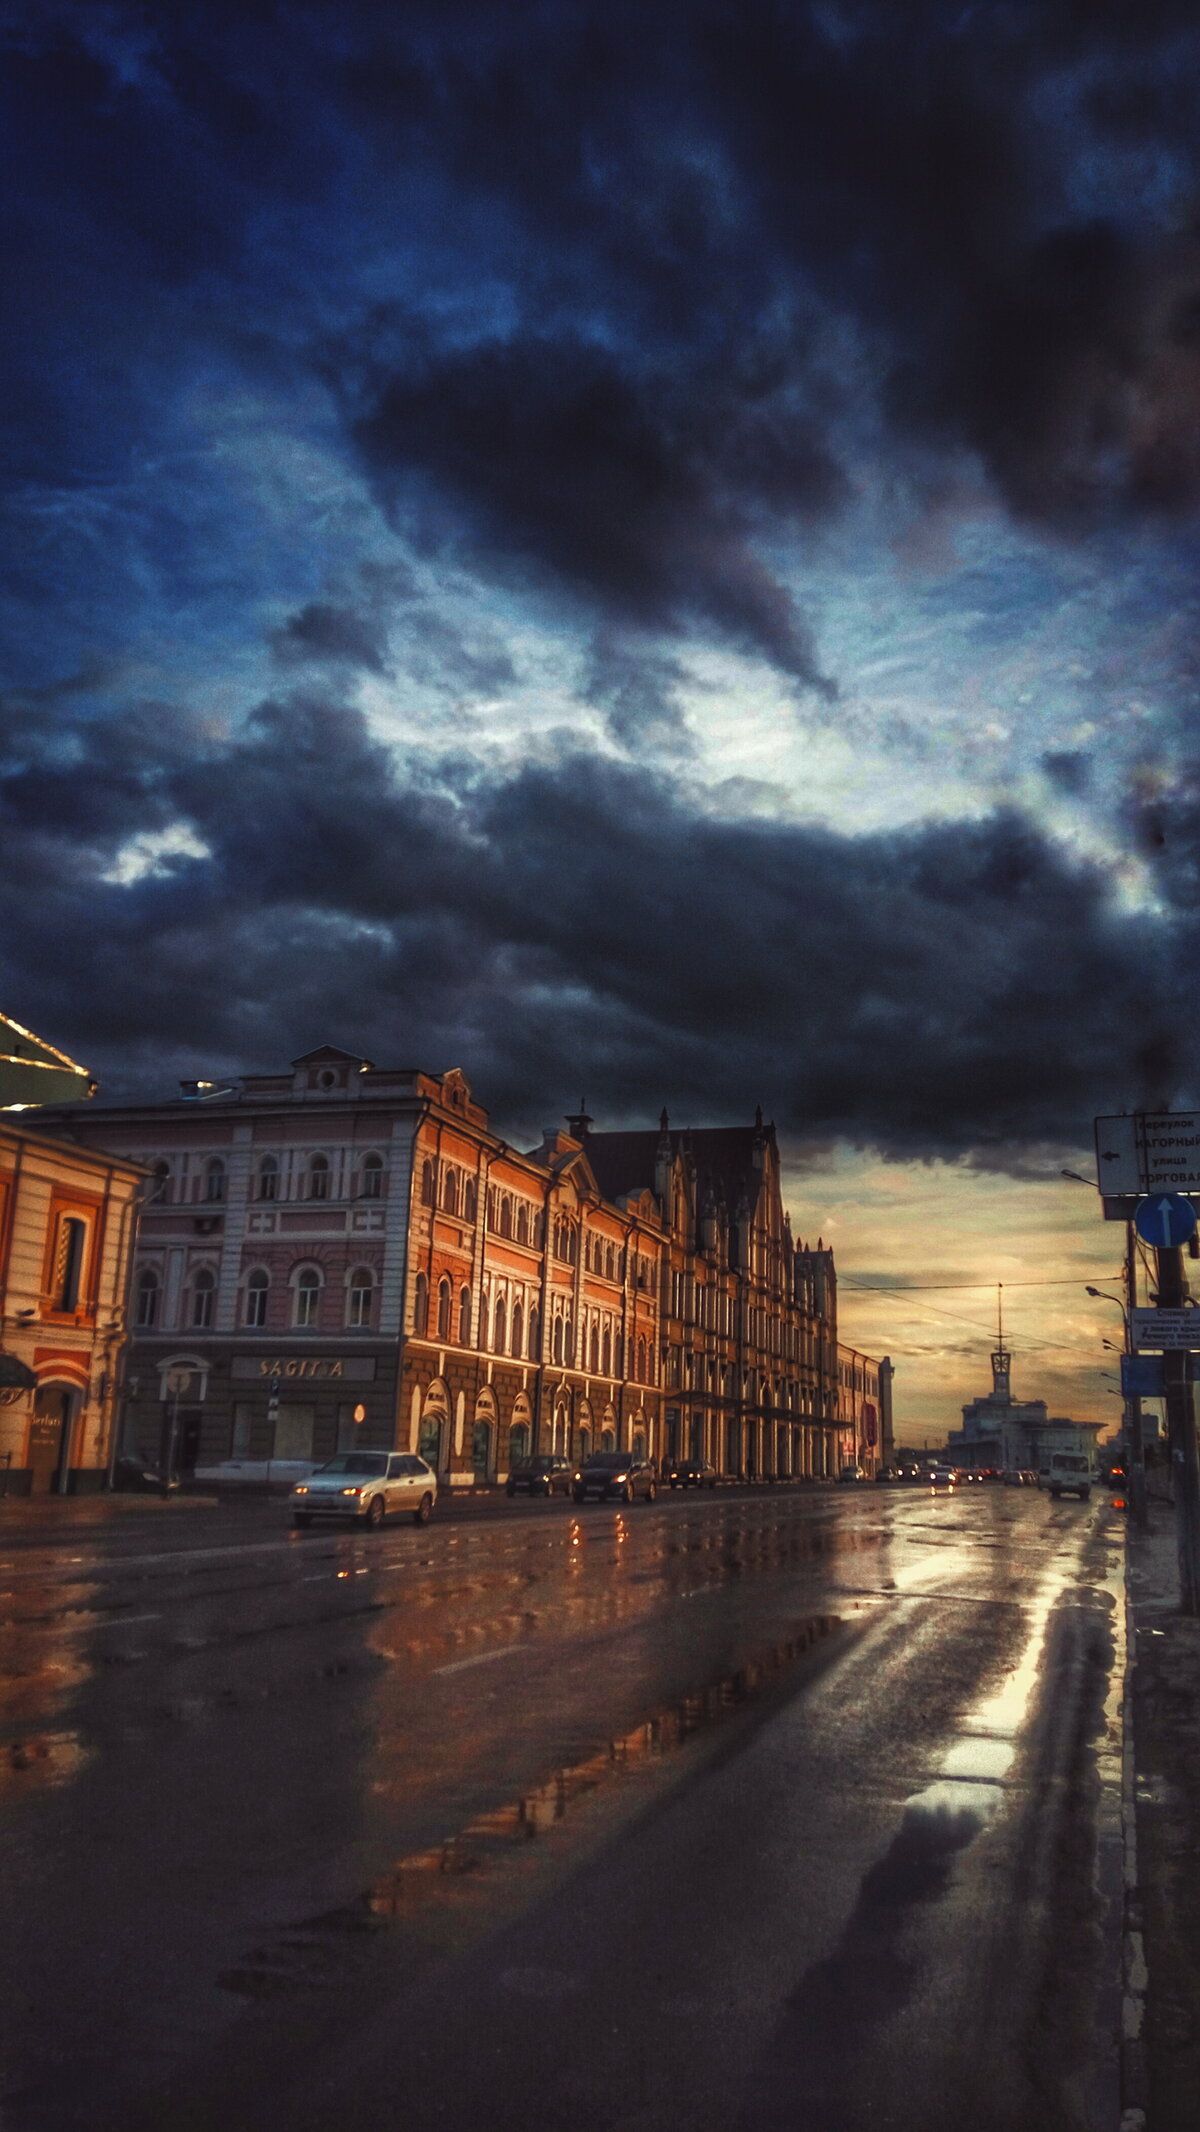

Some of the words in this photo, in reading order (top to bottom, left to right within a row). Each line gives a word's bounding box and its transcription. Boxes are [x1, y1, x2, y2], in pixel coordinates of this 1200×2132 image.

[1139, 1120, 1195, 1130] переулок
[1152, 1157, 1187, 1168] улица
[259, 1359, 344, 1377] SAGITA
